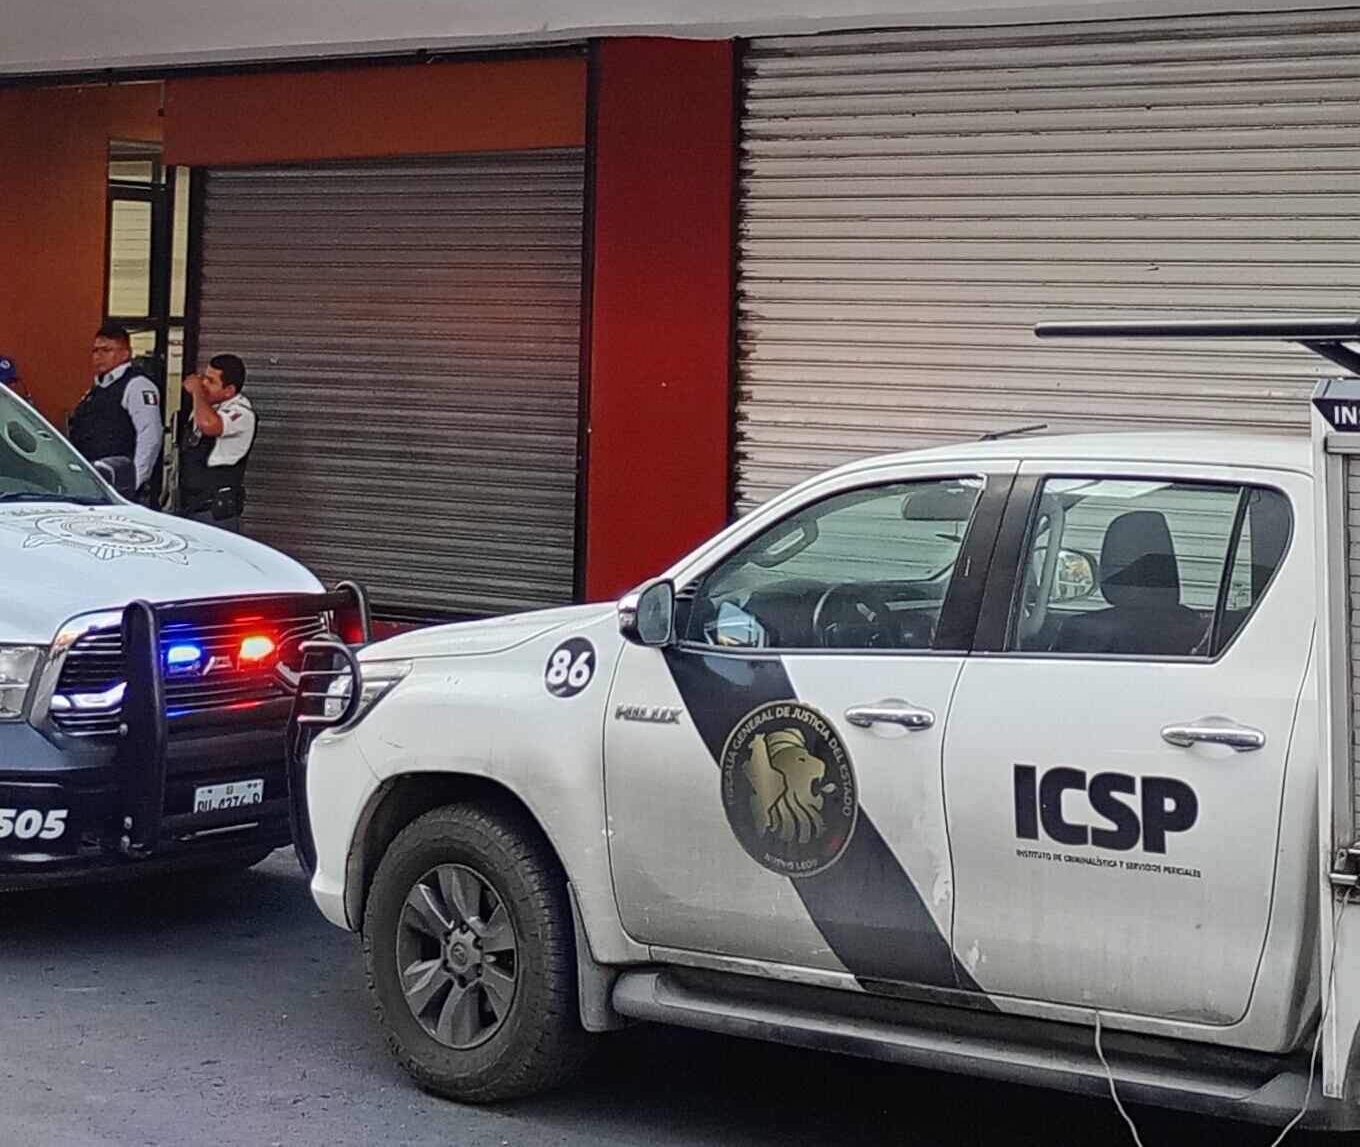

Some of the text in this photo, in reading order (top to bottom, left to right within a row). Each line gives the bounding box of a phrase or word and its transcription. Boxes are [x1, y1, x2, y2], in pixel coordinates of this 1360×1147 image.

[547, 649, 591, 687] 86
[732, 709, 774, 750] GENERAL
[775, 706, 791, 719] DE
[791, 709, 830, 741] JUSTICIA
[828, 739, 843, 763] DEL
[840, 763, 853, 817] ESTADO
[1014, 764, 1198, 854] ICSP
[1016, 849, 1052, 861] INSTITUTO
[1053, 853, 1062, 862] DE
[1118, 860, 1124, 868] Y
[1125, 861, 1161, 873] SERVICIOS
[1163, 866, 1201, 878] PERICIALES
